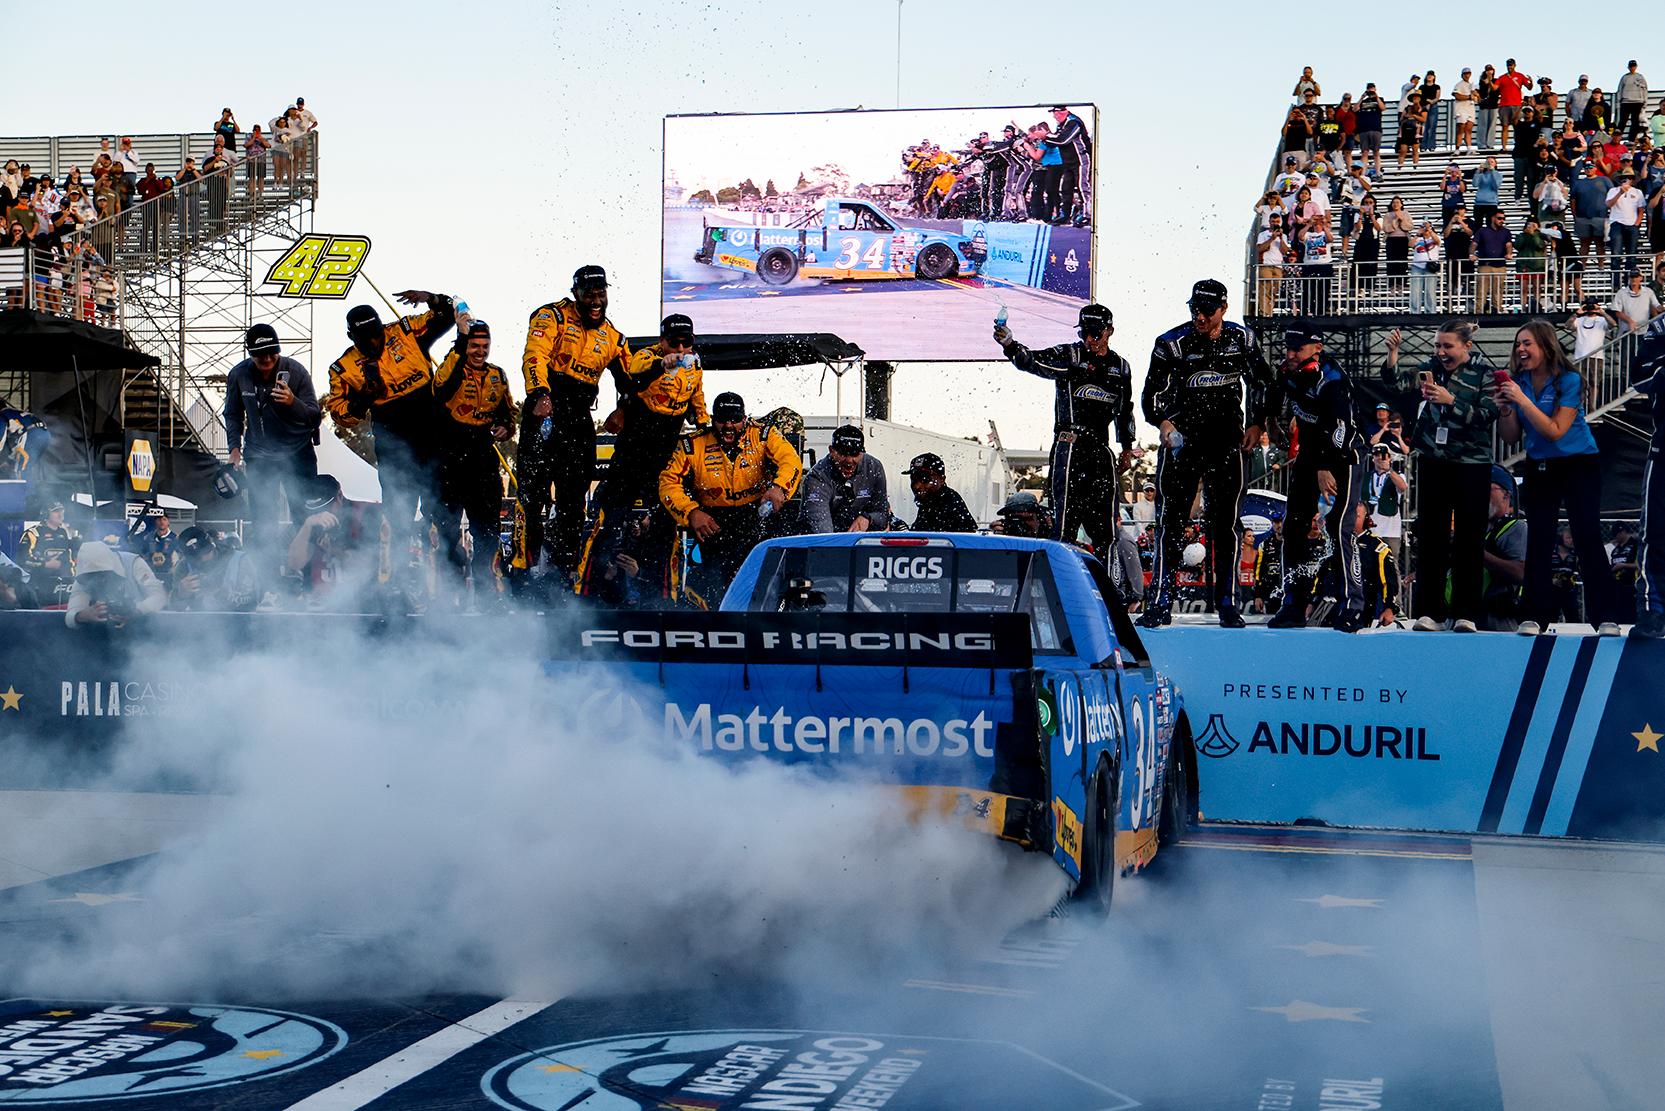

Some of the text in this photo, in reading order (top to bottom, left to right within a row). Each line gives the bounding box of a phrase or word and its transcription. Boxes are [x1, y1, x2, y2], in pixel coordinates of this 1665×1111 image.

[263, 233, 371, 299] 42
[834, 236, 886, 270] 34
[132, 454, 152, 477] NAPA
[868, 556, 943, 580] RIGGS
[580, 629, 746, 649] FORD
[61, 681, 121, 717] PALA
[1223, 683, 1408, 704] PRESENTED BY
[663, 702, 995, 758] Mattermost
[1247, 721, 1441, 761] ANDURIL
[1131, 694, 1156, 832] 34
[7, 1034, 166, 1085] NASCAR
[680, 1043, 790, 1097] NASCAR
